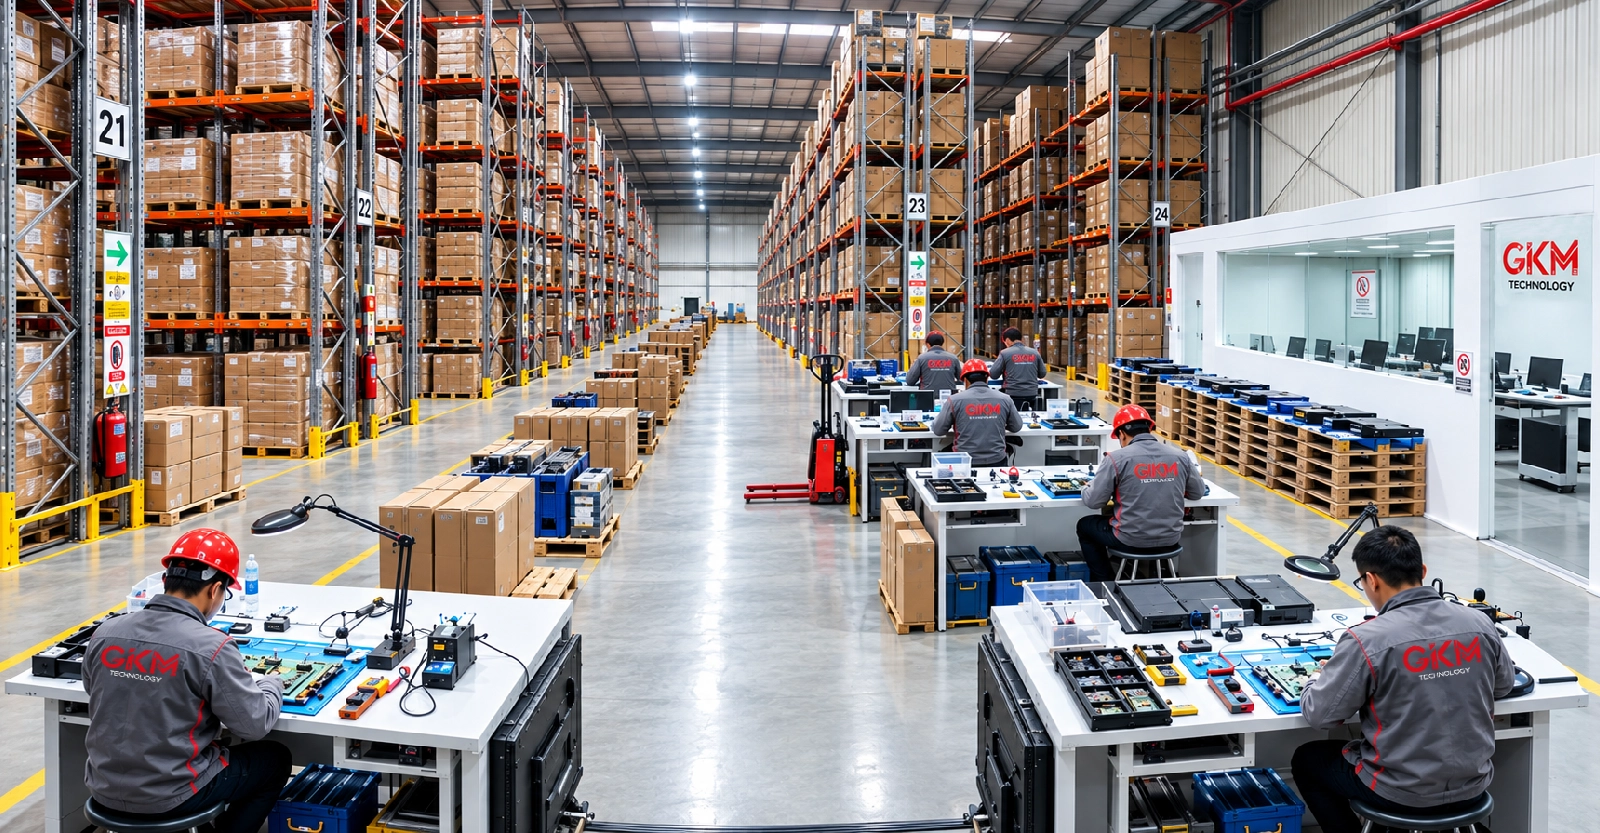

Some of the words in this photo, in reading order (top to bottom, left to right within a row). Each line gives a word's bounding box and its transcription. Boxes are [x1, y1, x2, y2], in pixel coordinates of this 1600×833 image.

[99, 109, 125, 148] 21
[358, 197, 371, 219] 22
[909, 197, 926, 213] 23
[1154, 207, 1168, 221] 24
[1502, 239, 1579, 276] GKM
[1508, 280, 1575, 292] TECHNOLOGY
[1133, 461, 1179, 479] GKM
[101, 645, 180, 677] GKM
[1402, 635, 1482, 673] GKM
[109, 669, 162, 683] TECHNOLOGY
